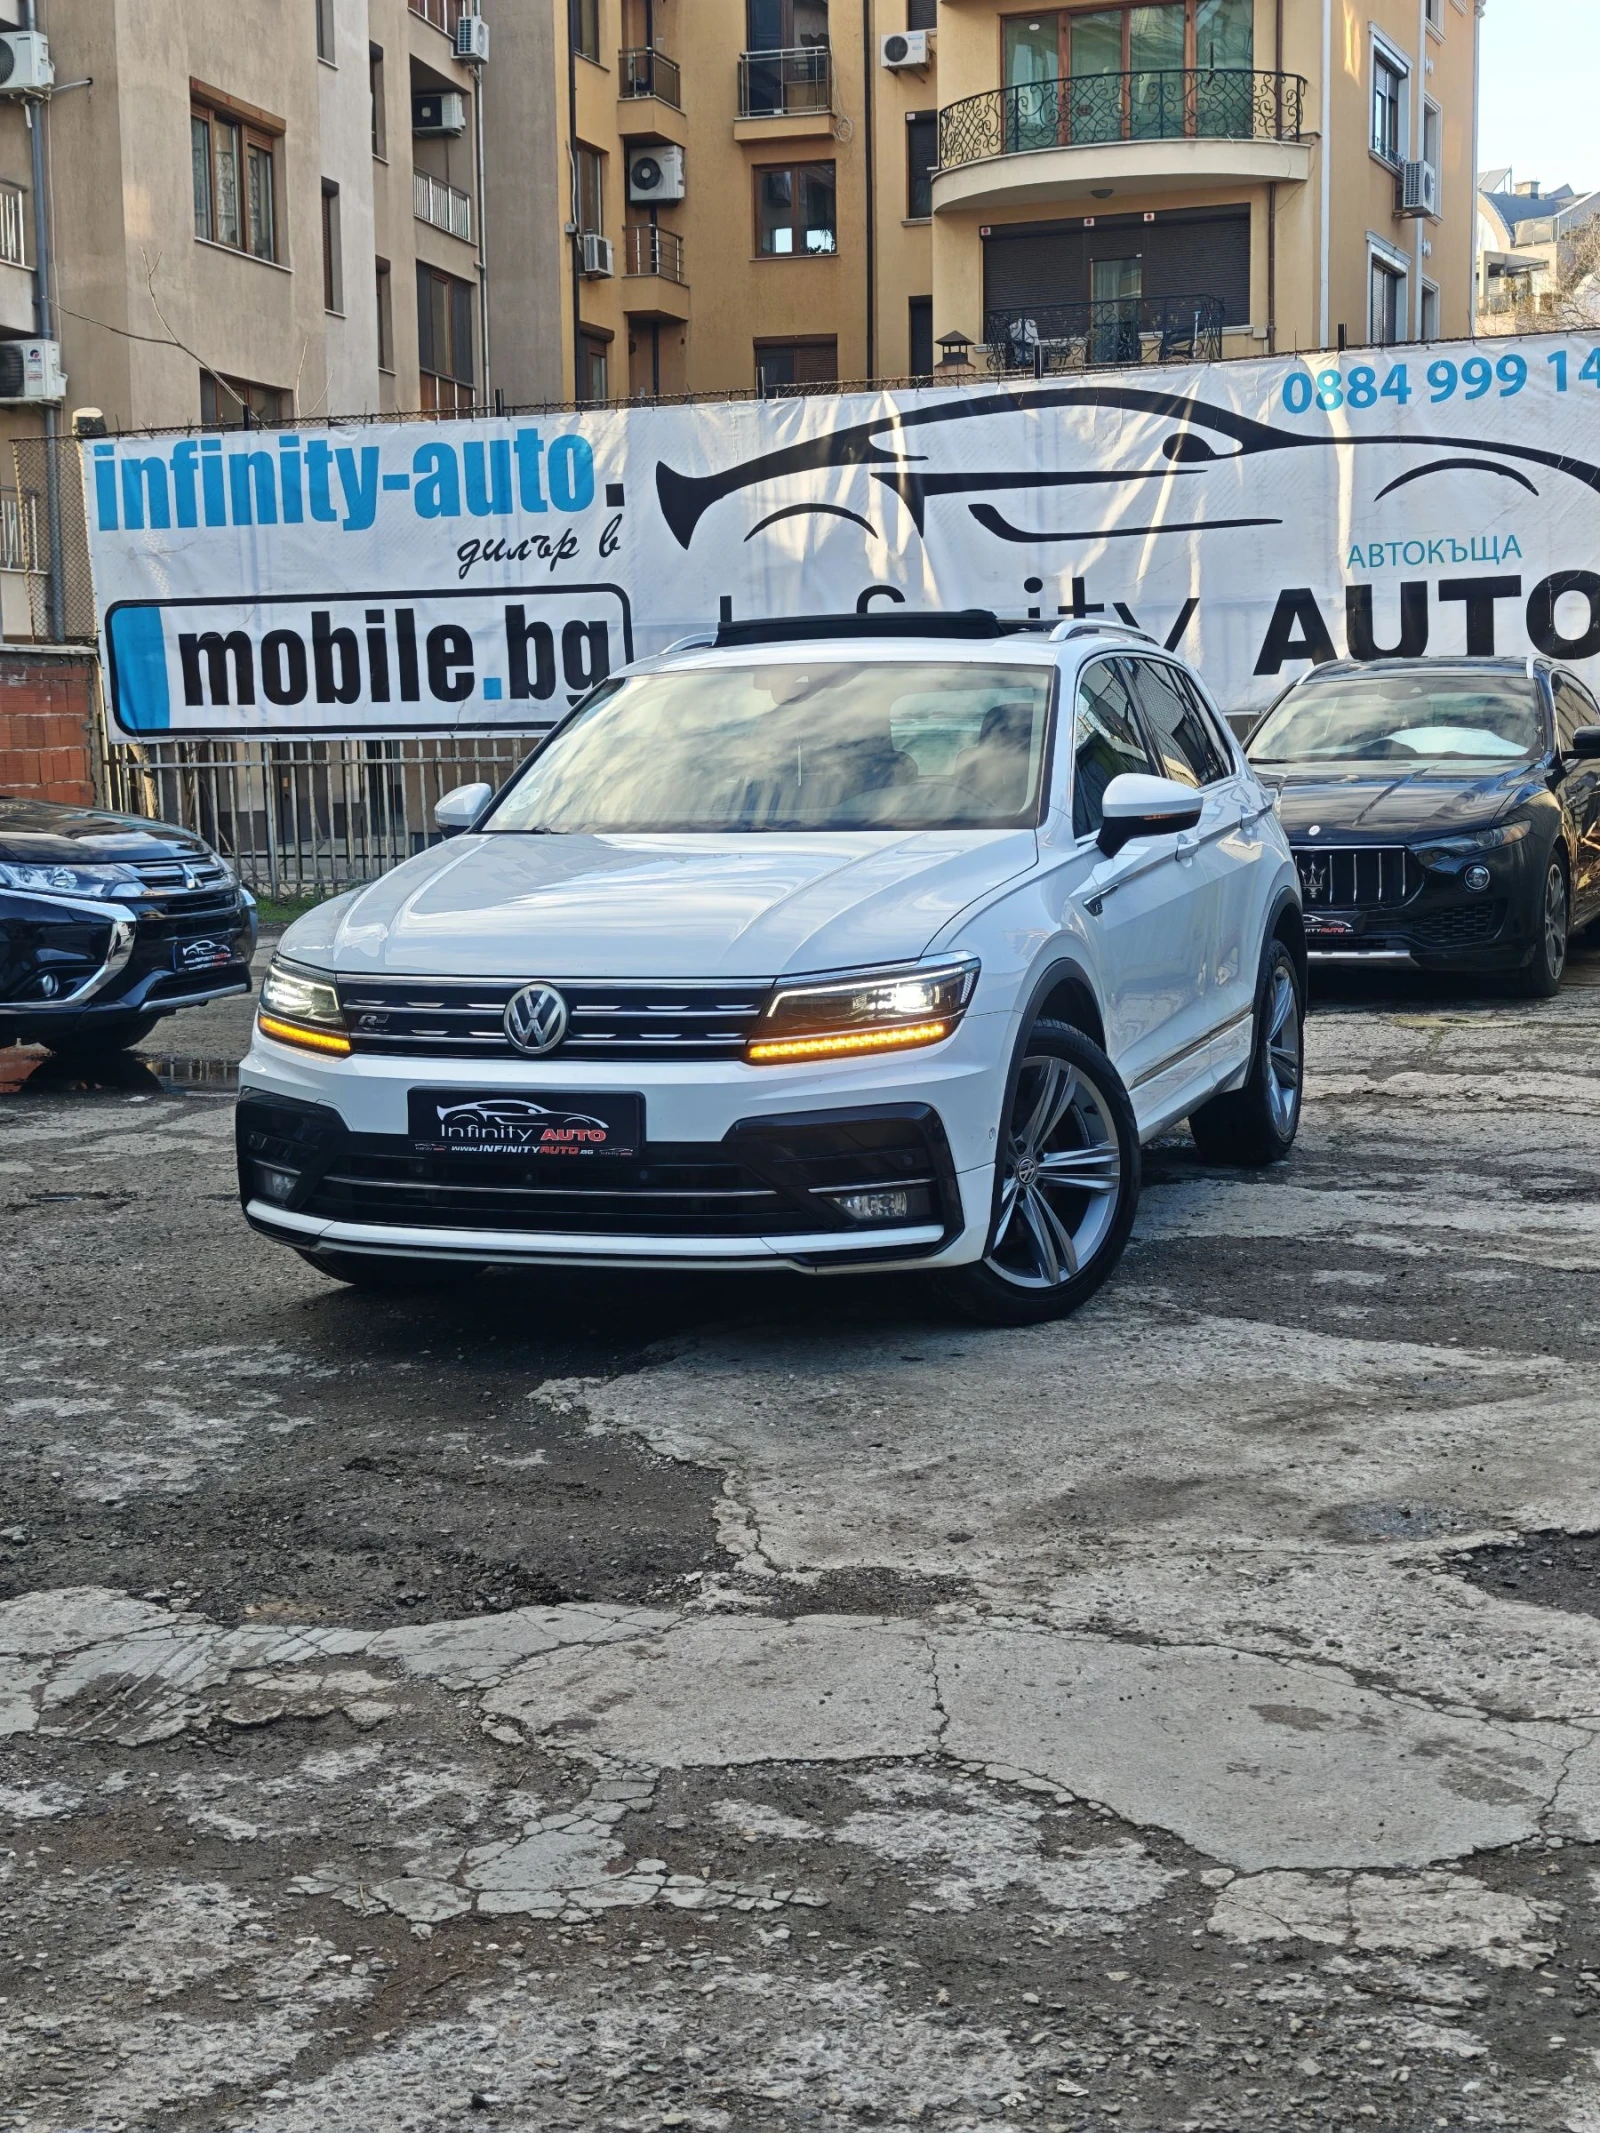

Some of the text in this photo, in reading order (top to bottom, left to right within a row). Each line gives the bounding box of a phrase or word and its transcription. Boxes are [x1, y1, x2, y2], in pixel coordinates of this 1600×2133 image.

[1282, 364, 1412, 414] 0884
[1426, 354, 1528, 404] 999
[458, 513, 622, 579] дилър в
[1347, 534, 1522, 569] АВТОКЪЩА
[1252, 570, 1600, 676] AUTO
[179, 603, 610, 707] mobile.bg
[441, 1124, 607, 1142] Infinity AUTO
